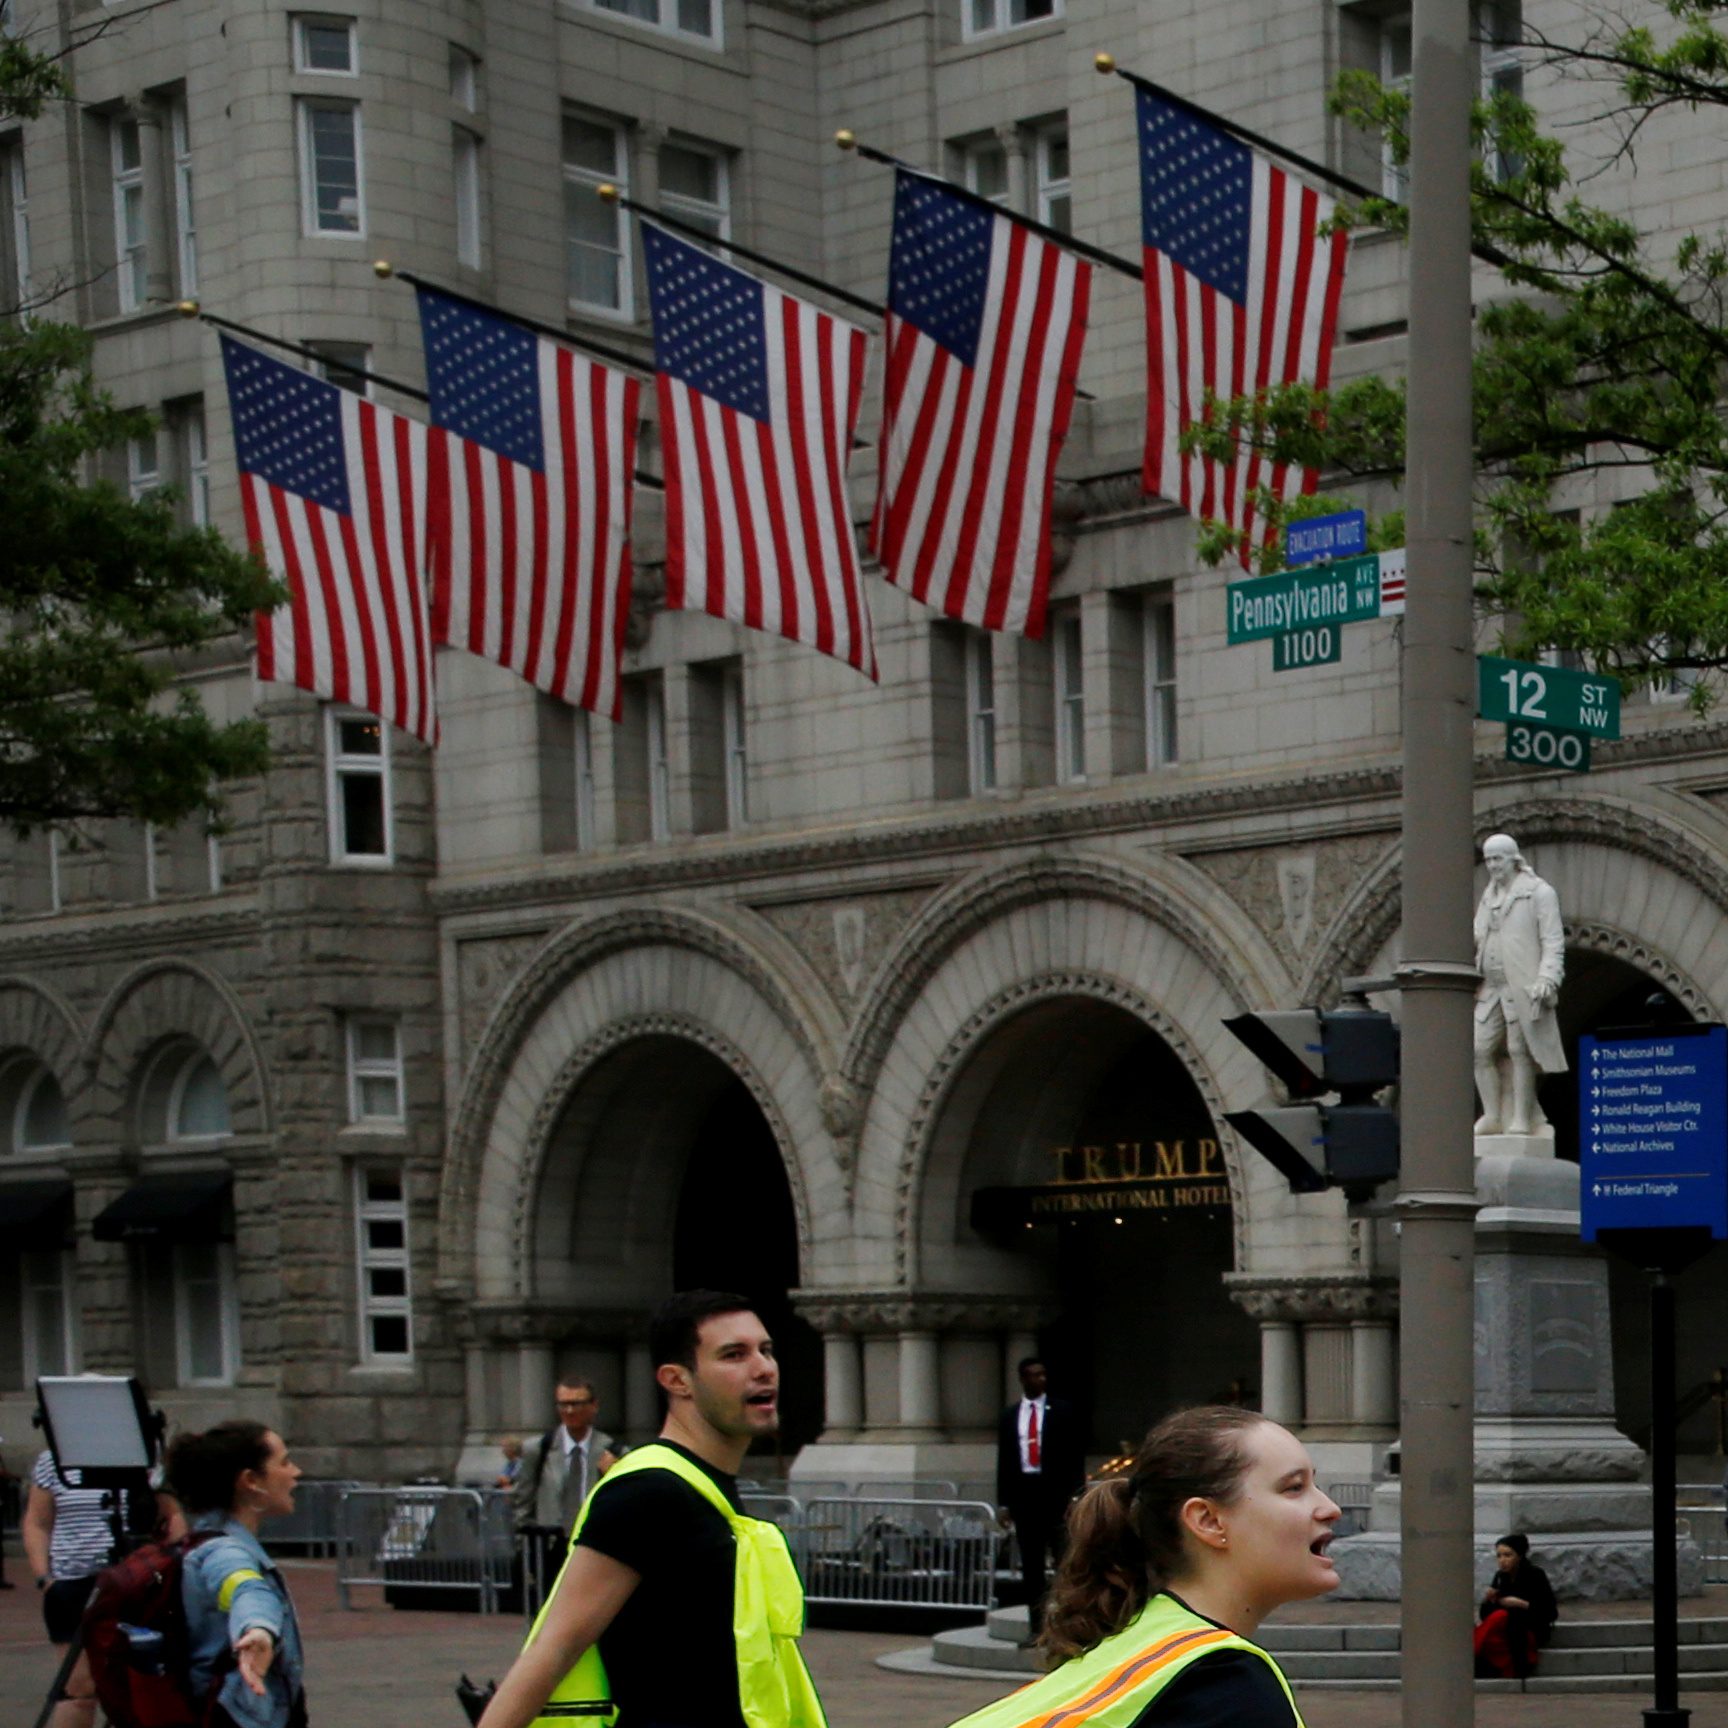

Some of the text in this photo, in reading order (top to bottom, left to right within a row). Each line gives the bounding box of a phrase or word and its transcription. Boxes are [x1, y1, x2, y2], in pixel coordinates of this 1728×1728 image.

[1290, 521, 1361, 555] EVACUATION ROUTE
[1232, 563, 1375, 633] Pennsylvania AVE
[1356, 587, 1375, 609] NW
[1282, 627, 1332, 666] 1100
[1500, 669, 1607, 719] 12 ST
[1579, 706, 1608, 729] NW
[1511, 727, 1582, 767] 300
[1602, 1044, 1674, 1060] The National Mall
[1602, 1064, 1696, 1079] Smithsonian Museums
[1602, 1083, 1662, 1098] Freedom Plaza
[1602, 1100, 1701, 1117] Ronald Reagan Building
[1602, 1122, 1627, 1134] White
[1628, 1122, 1655, 1133] House
[1655, 1120, 1682, 1132] Visitor
[1602, 1140, 1674, 1153] National Archives
[1052, 1138, 1217, 1182] TRUMP
[1032, 1185, 1231, 1213] INTERNATIONAL HOTEL
[1613, 1183, 1644, 1196] Federal
[1644, 1182, 1679, 1197] Triangle
